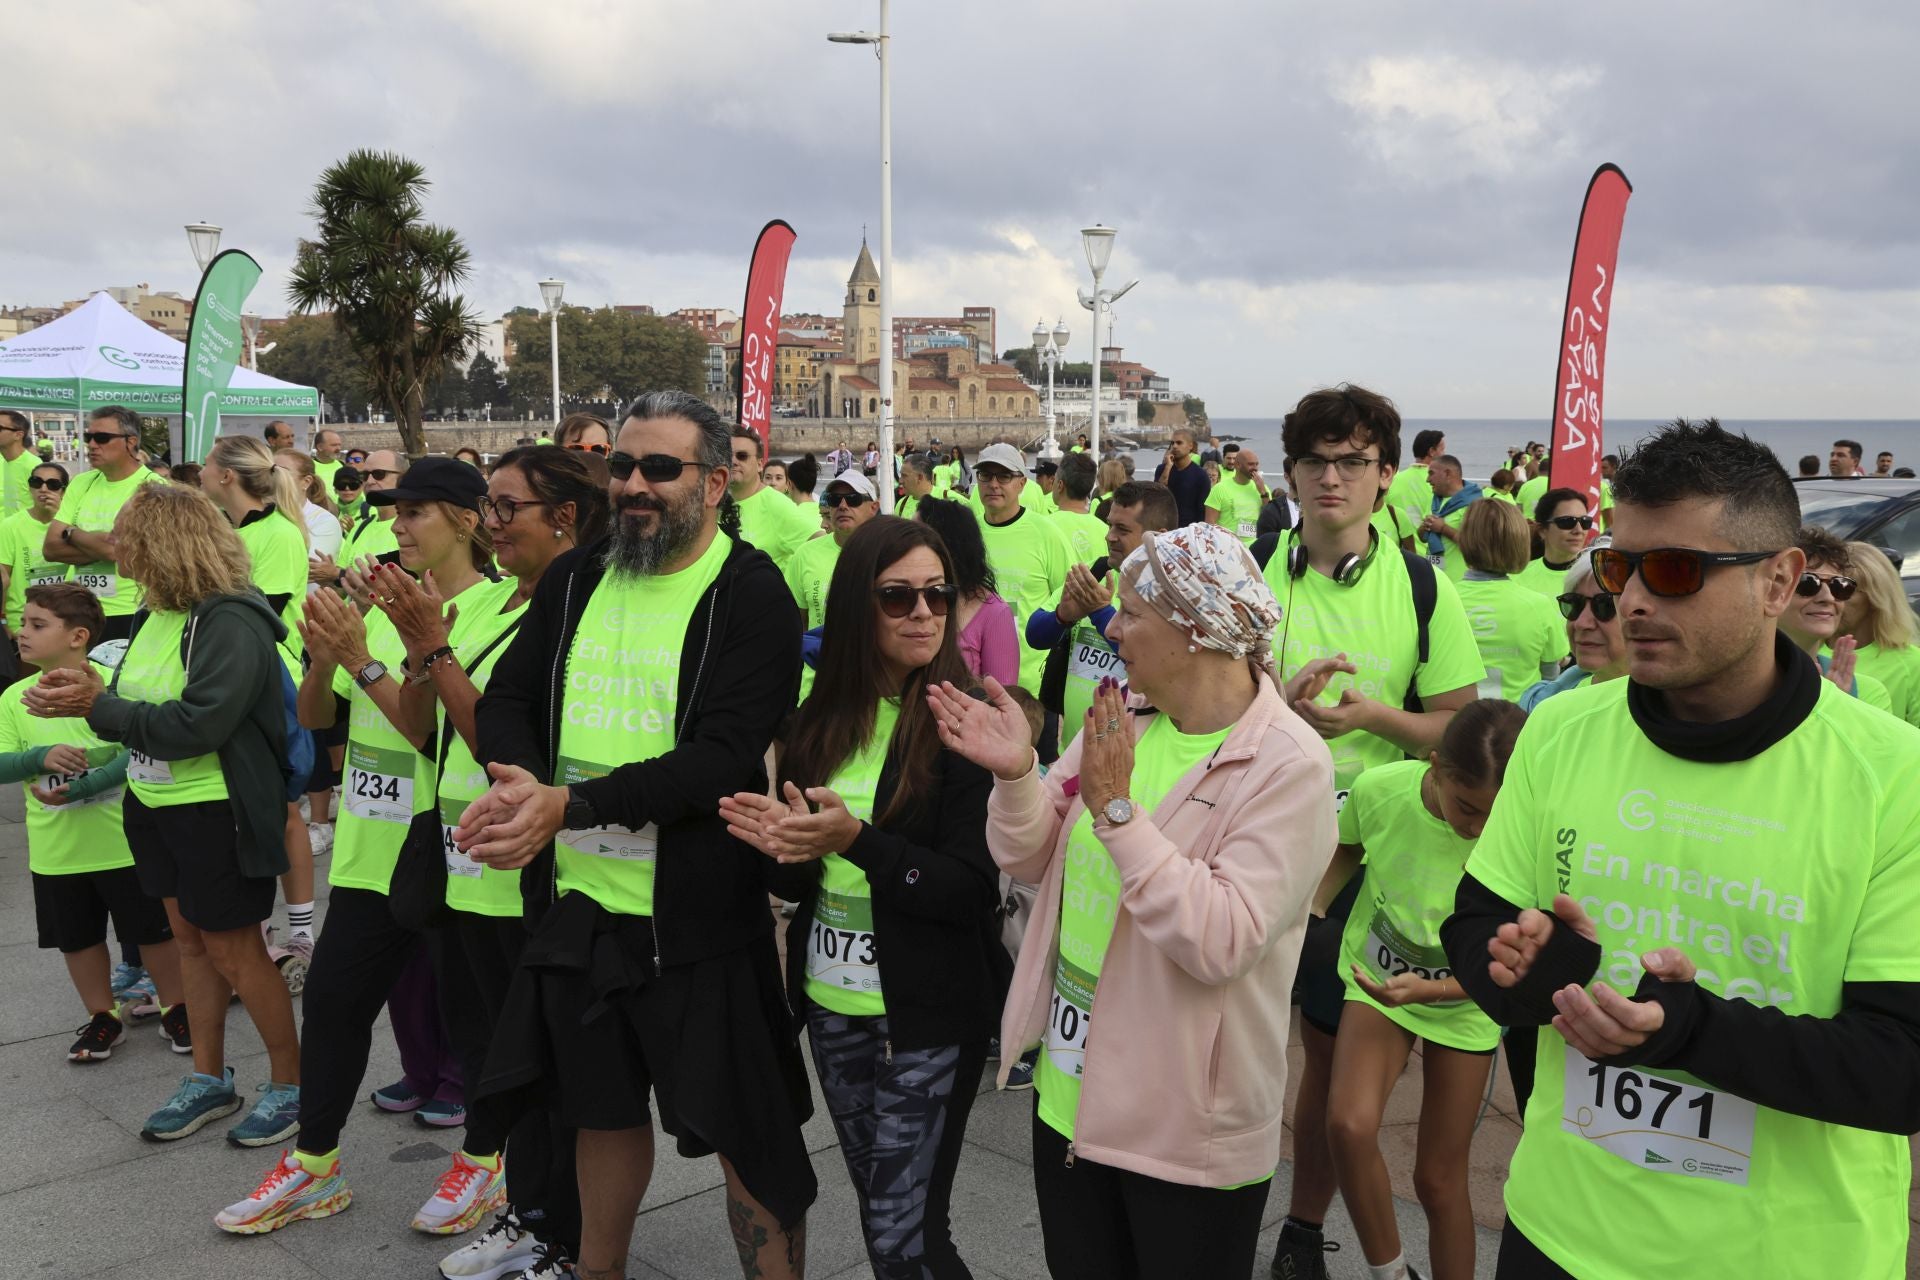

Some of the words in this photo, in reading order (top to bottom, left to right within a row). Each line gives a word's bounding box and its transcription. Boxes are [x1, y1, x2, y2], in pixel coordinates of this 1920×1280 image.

[87, 390, 159, 403] ASOCIACIÓN
[1562, 306, 1586, 451] CYASA
[275, 395, 314, 407] CÁNCER
[577, 637, 608, 663] En
[1078, 645, 1121, 671] 0507
[351, 769, 400, 802] 1234
[1556, 828, 1577, 895] RIAS
[1581, 842, 1631, 881] En
[1642, 859, 1806, 923] marcha
[814, 923, 877, 965] 1073
[1578, 895, 1734, 957] contra
[1742, 931, 1793, 974] el
[1588, 1063, 1714, 1139] 1671
